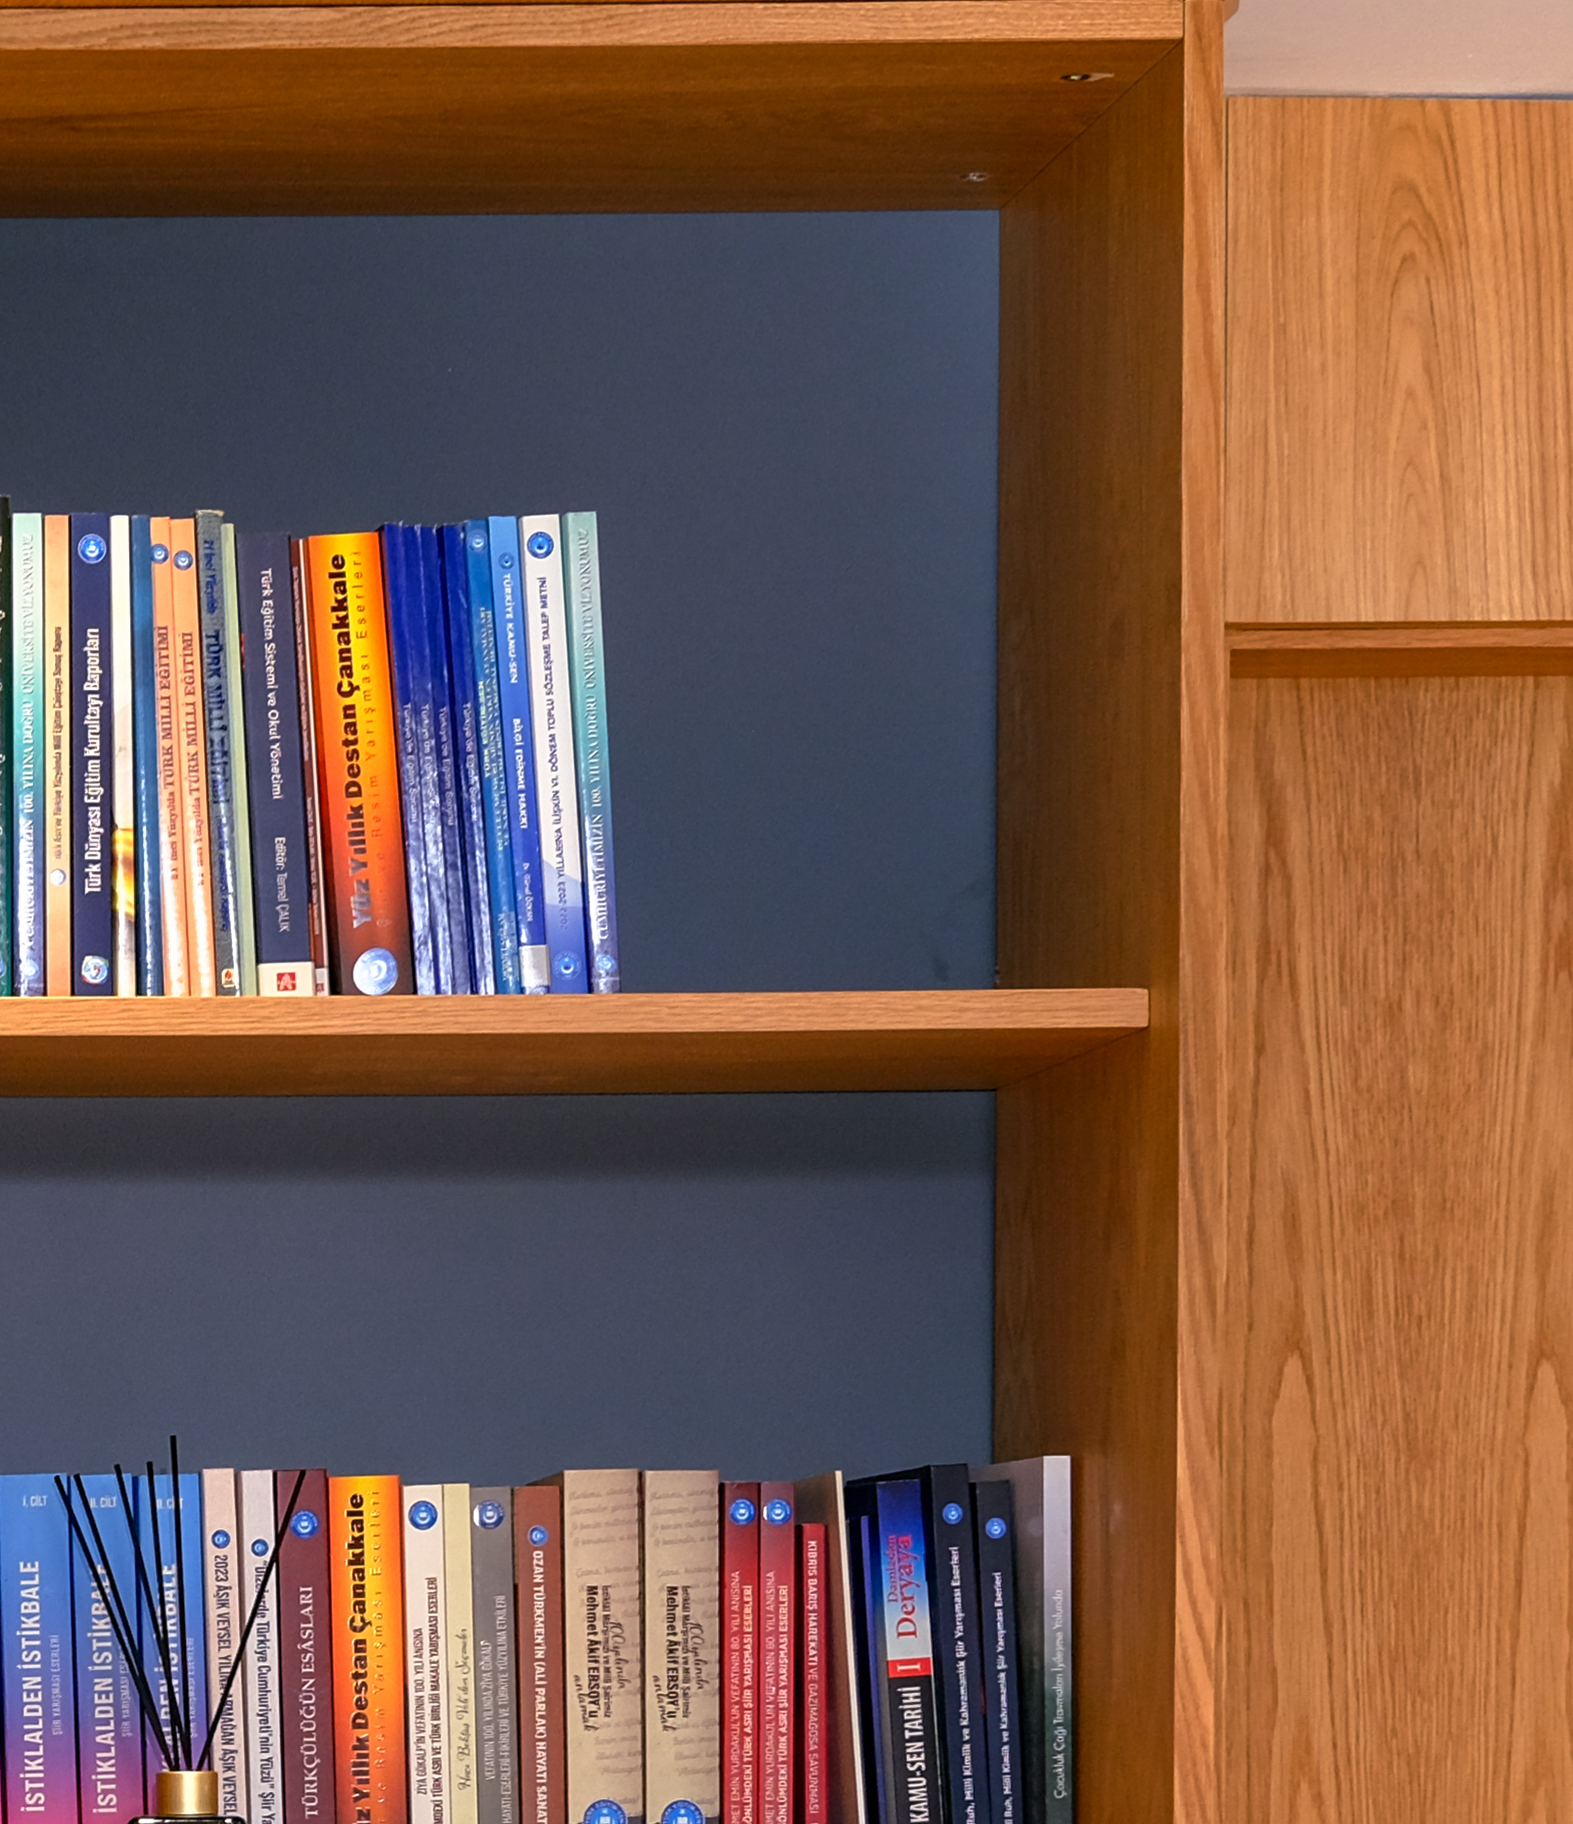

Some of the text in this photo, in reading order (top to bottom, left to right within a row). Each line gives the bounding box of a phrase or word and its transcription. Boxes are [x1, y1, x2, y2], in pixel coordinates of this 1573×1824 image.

[154, 626, 171, 690] EĞİTİMİ
[502, 573, 519, 683] TÜRKİYE KAMU-SEN
[157, 695, 173, 741] MİLLİ
[260, 568, 284, 800] Türk Eğitim Sistemi ve Okul Yönetimi
[351, 551, 382, 836] Resim Yarışması Eserleri
[83, 628, 104, 895] Türk Dünyası Eğitim Kurultayı Raporları
[160, 745, 175, 789] TÜRK
[328, 554, 373, 928] Yüz Yıllık Destan Çanakkale
[344, 1493, 372, 1633] Çanakkale
[532, 1550, 544, 1581] OZAN
[896, 1535, 920, 1639] Deryaya
[214, 1555, 232, 1651] 2023 ÂŞIK VEYSEL
[532, 1584, 547, 1658] TÜRKMEN'İN
[741, 1586, 752, 1632] ESERLERİ
[807, 1540, 819, 1665] KIBRIS BARIŞ HAREKATI
[16, 1561, 45, 1812] İSTİKLALDEN İSTİKBALE
[347, 1639, 369, 1730] Destan
[533, 1661, 548, 1685] (ALİ
[742, 1634, 754, 1687] YARIŞMASI
[1051, 1590, 1067, 1799] Çocukluk Çağı Travmaları İyileşme Yolunda
[297, 1586, 320, 1819] TÜRKÇÜLÜĞÜN ESÂSLARI
[533, 1687, 548, 1738] PARLAK)
[741, 1690, 753, 1708] ŞİİR
[743, 1710, 752, 1734] ASRI
[897, 1686, 924, 1739] TARİHİ
[350, 1734, 370, 1803] Yıllık
[535, 1741, 548, 1783] HAYATI
[742, 1736, 752, 1762] TÜRK
[906, 1742, 930, 1823] KAMU-SEN
